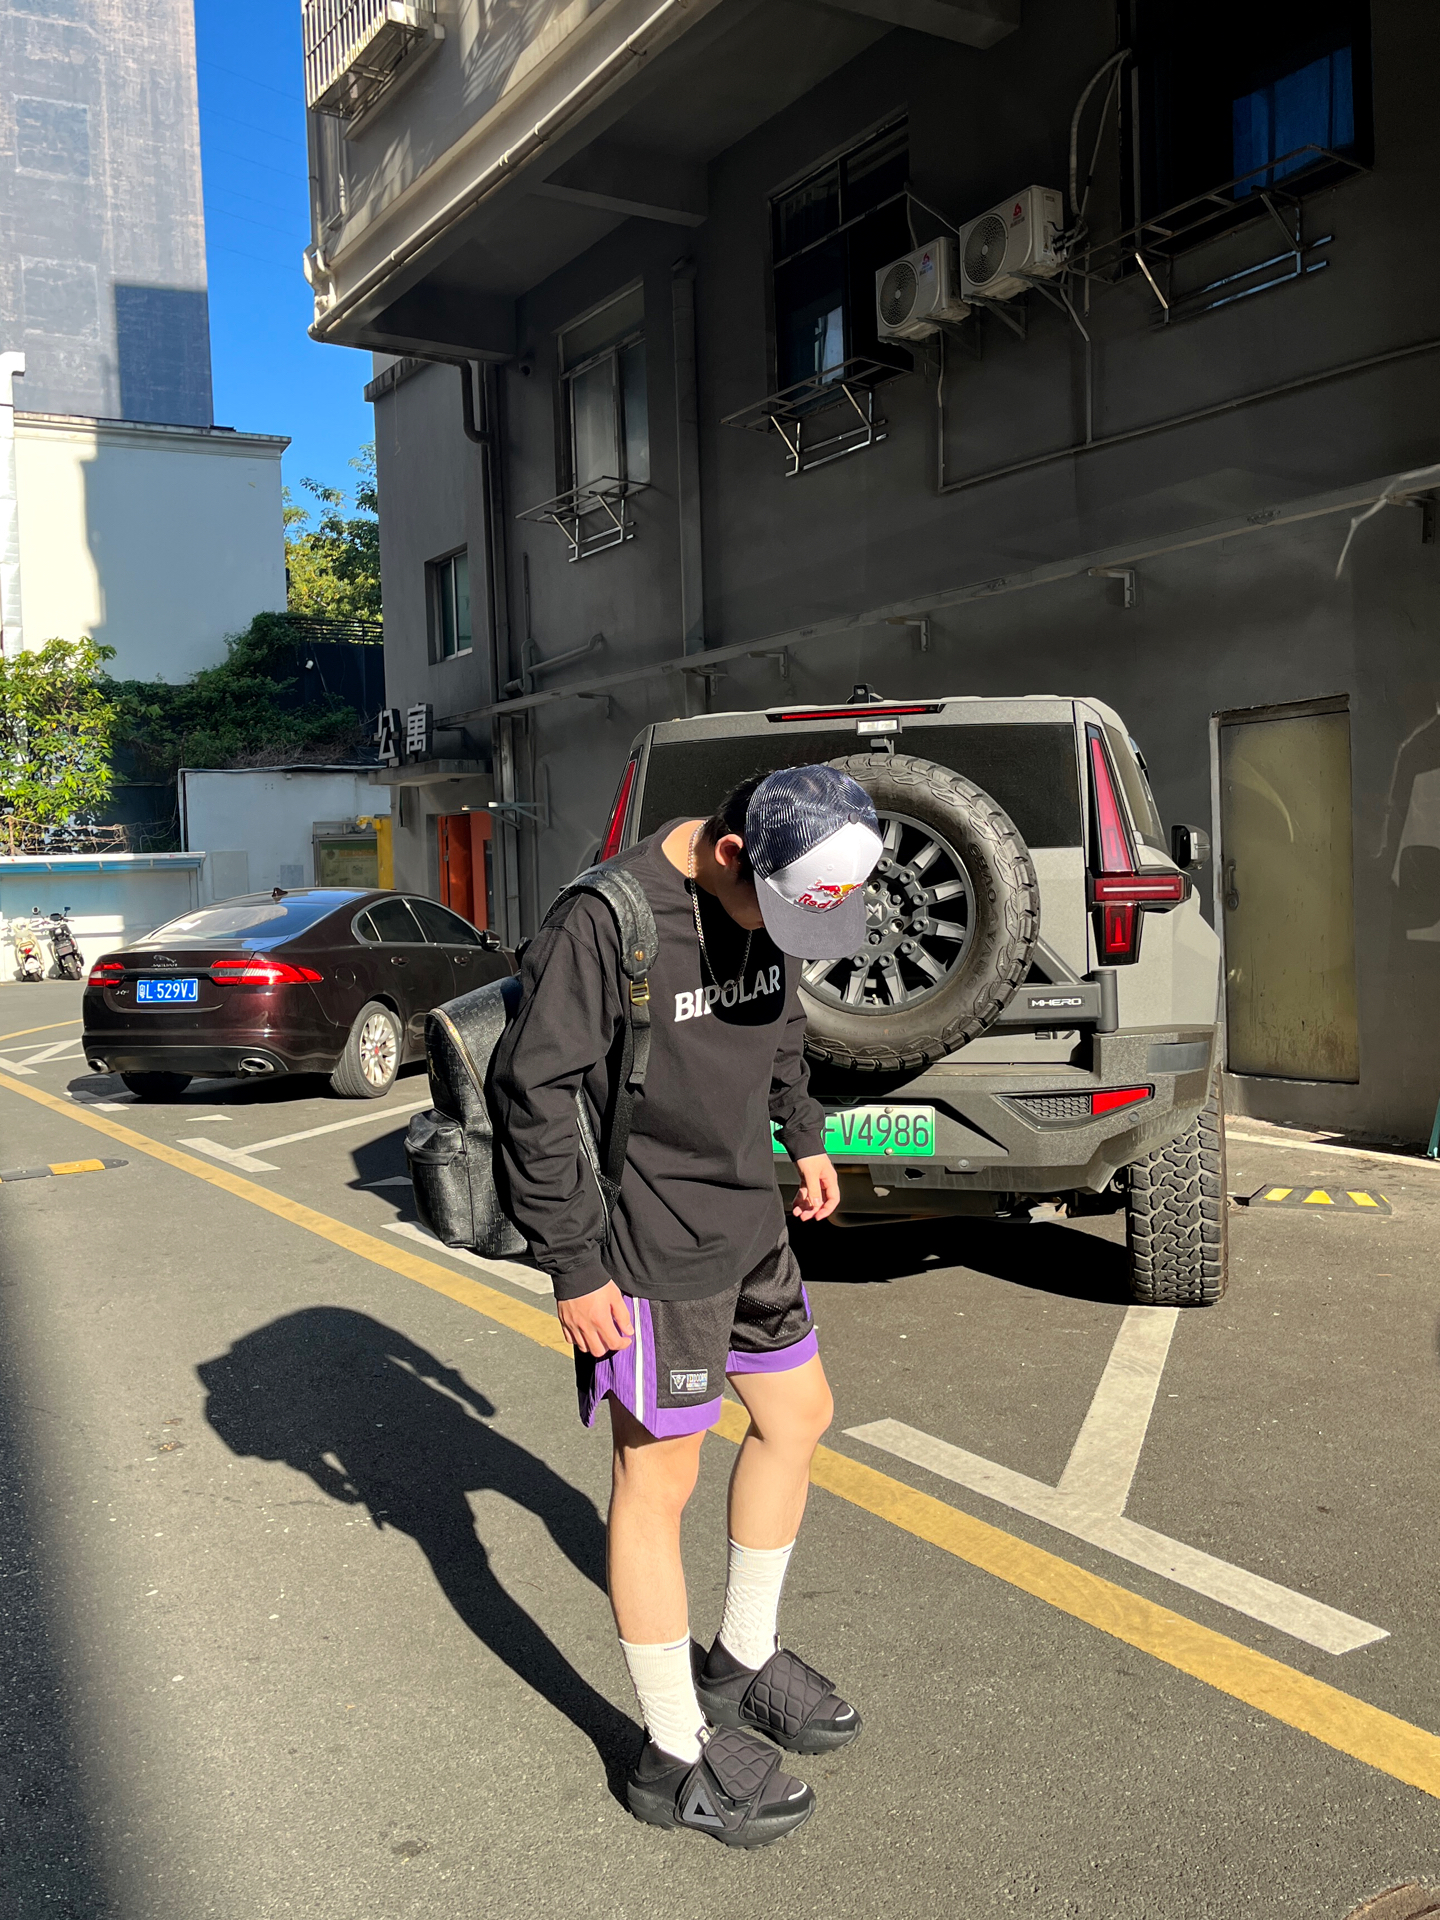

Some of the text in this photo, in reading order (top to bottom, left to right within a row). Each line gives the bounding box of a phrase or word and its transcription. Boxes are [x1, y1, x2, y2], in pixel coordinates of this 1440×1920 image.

[378, 702, 426, 760] 公寓
[797, 893, 833, 909] Red
[674, 965, 781, 1022] BIPOLAR
[1031, 997, 1082, 1007] MHERO
